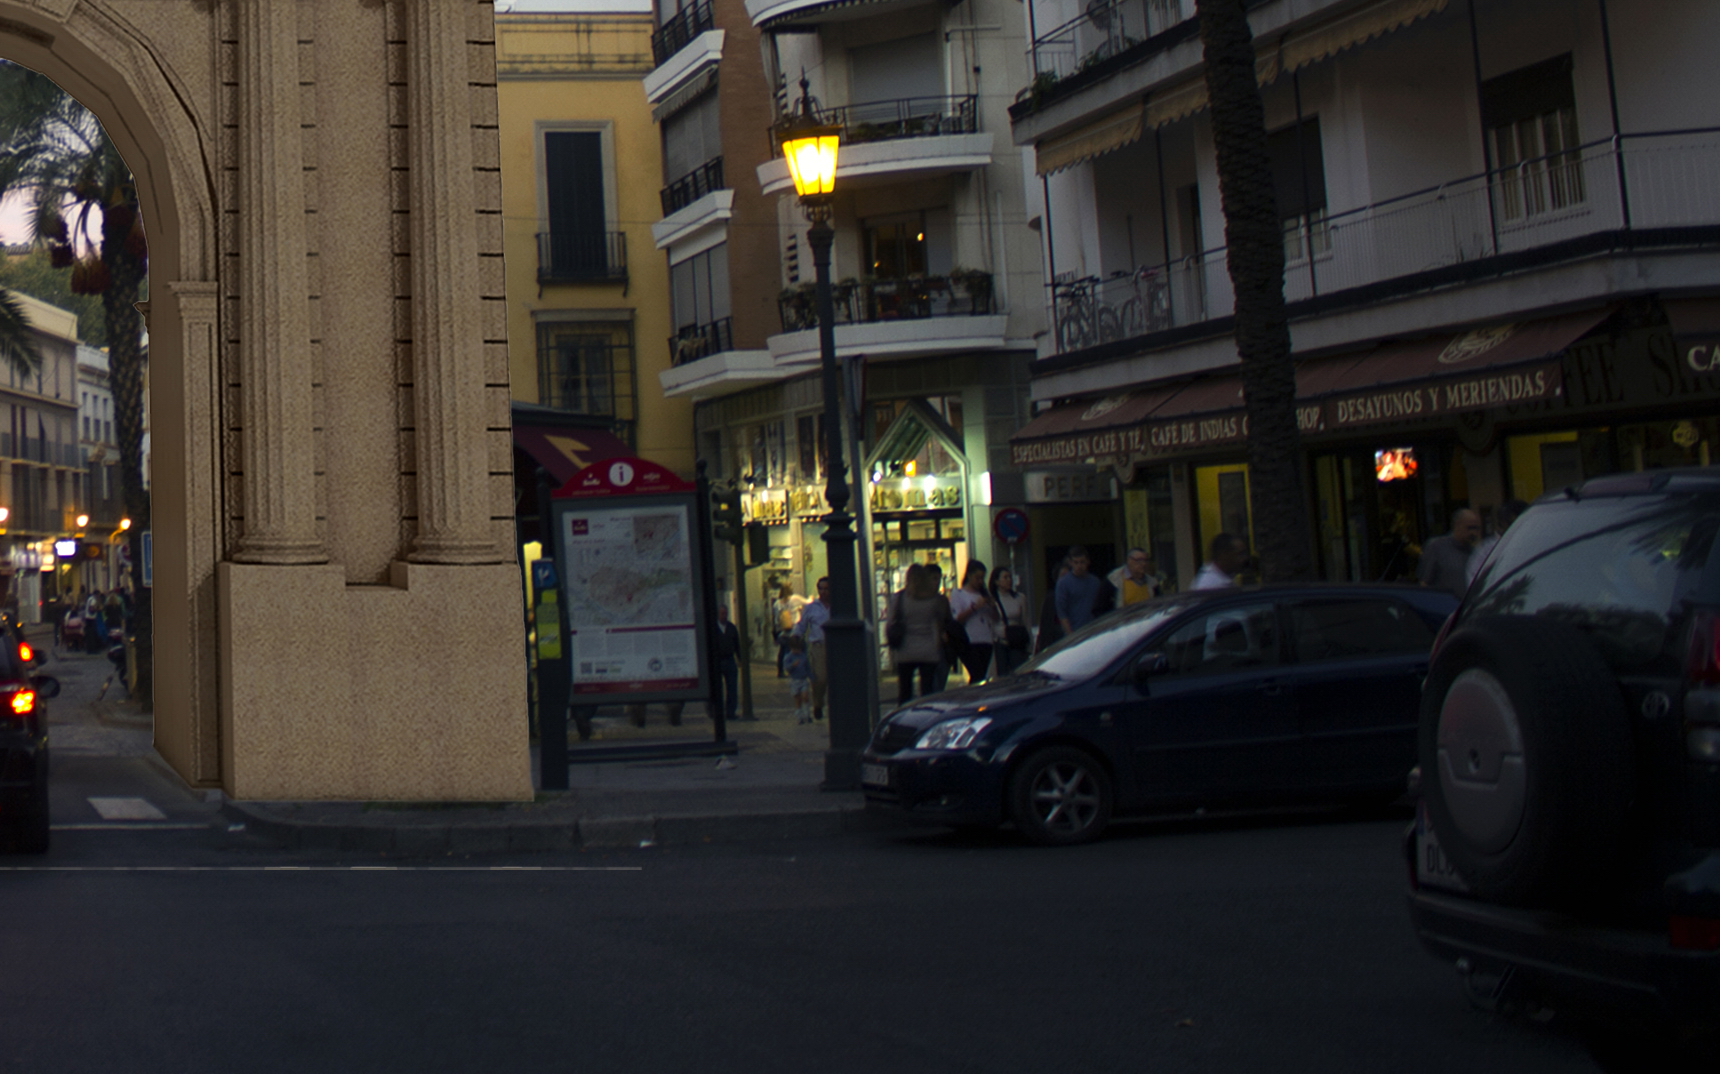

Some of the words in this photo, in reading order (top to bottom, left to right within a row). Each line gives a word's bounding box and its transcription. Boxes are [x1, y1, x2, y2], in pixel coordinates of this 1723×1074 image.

[1337, 388, 1422, 424] DESAYUNOS
[1427, 385, 1442, 412] Y
[1446, 370, 1545, 407] MERIENDAS
[1013, 439, 1076, 464] ESPECIALISTAS
[1077, 436, 1091, 456] EN
[1118, 431, 1126, 451] Y
[1151, 421, 1179, 446] CAFÉ
[1181, 422, 1196, 444] DE
[1199, 416, 1238, 441] INDIAS
